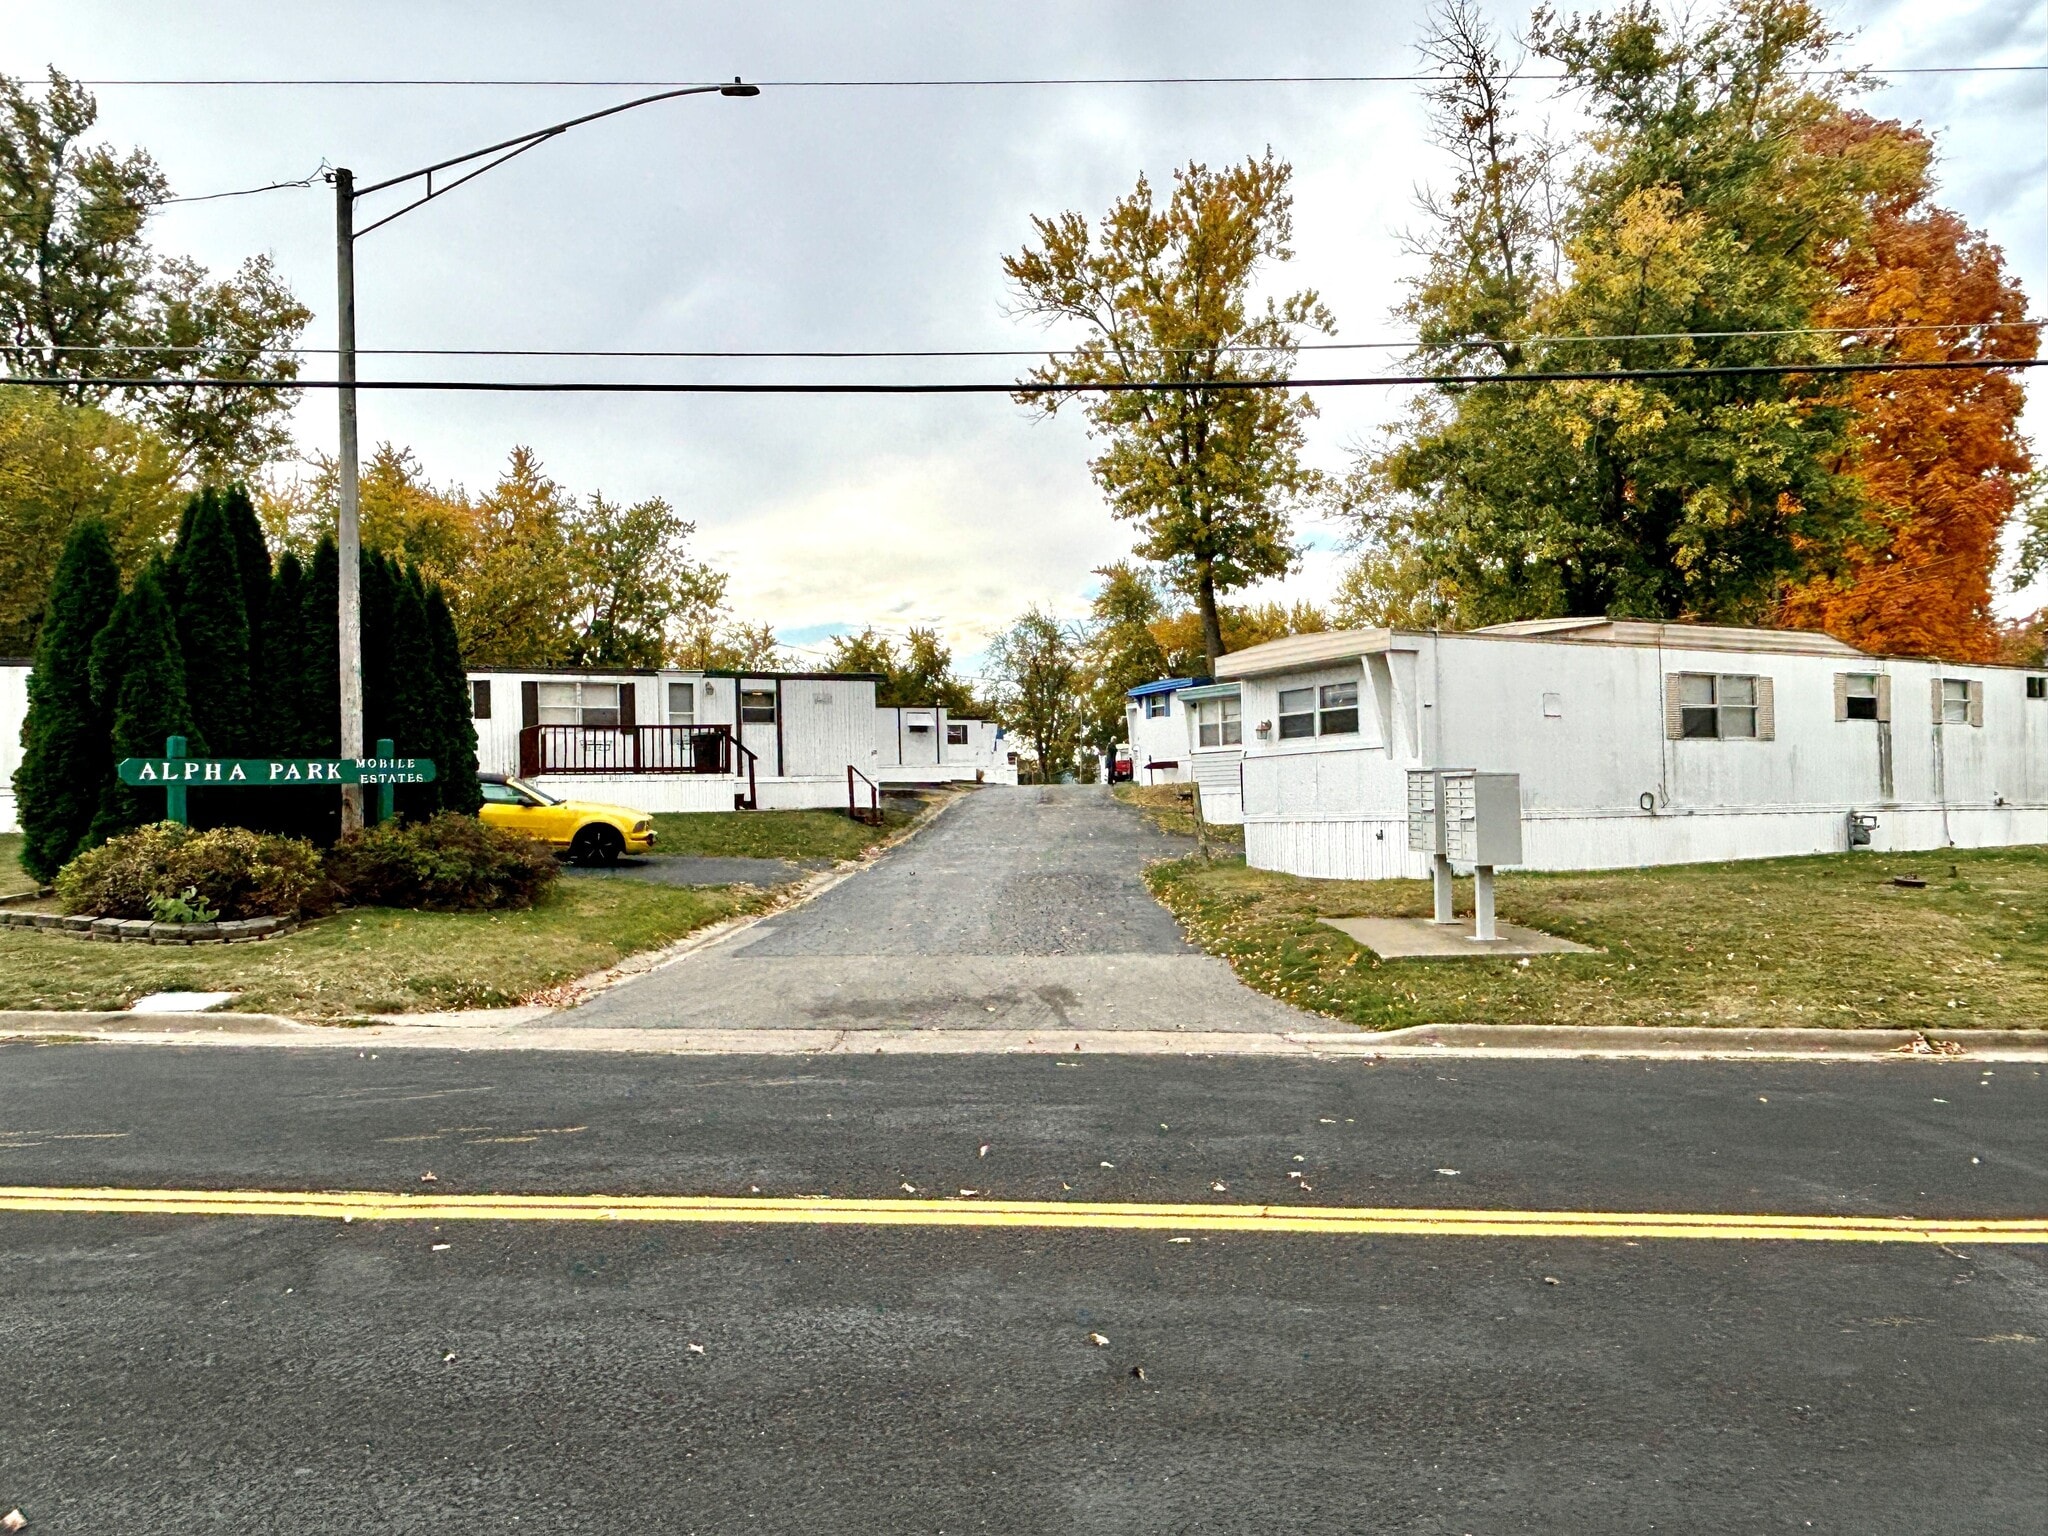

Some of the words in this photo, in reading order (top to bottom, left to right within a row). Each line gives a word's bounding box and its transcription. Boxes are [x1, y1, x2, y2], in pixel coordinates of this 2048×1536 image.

[355, 758, 416, 769] MOBILE
[138, 762, 248, 781] ALPHA
[269, 762, 342, 780] PARK
[360, 773, 424, 784] ESTATES
